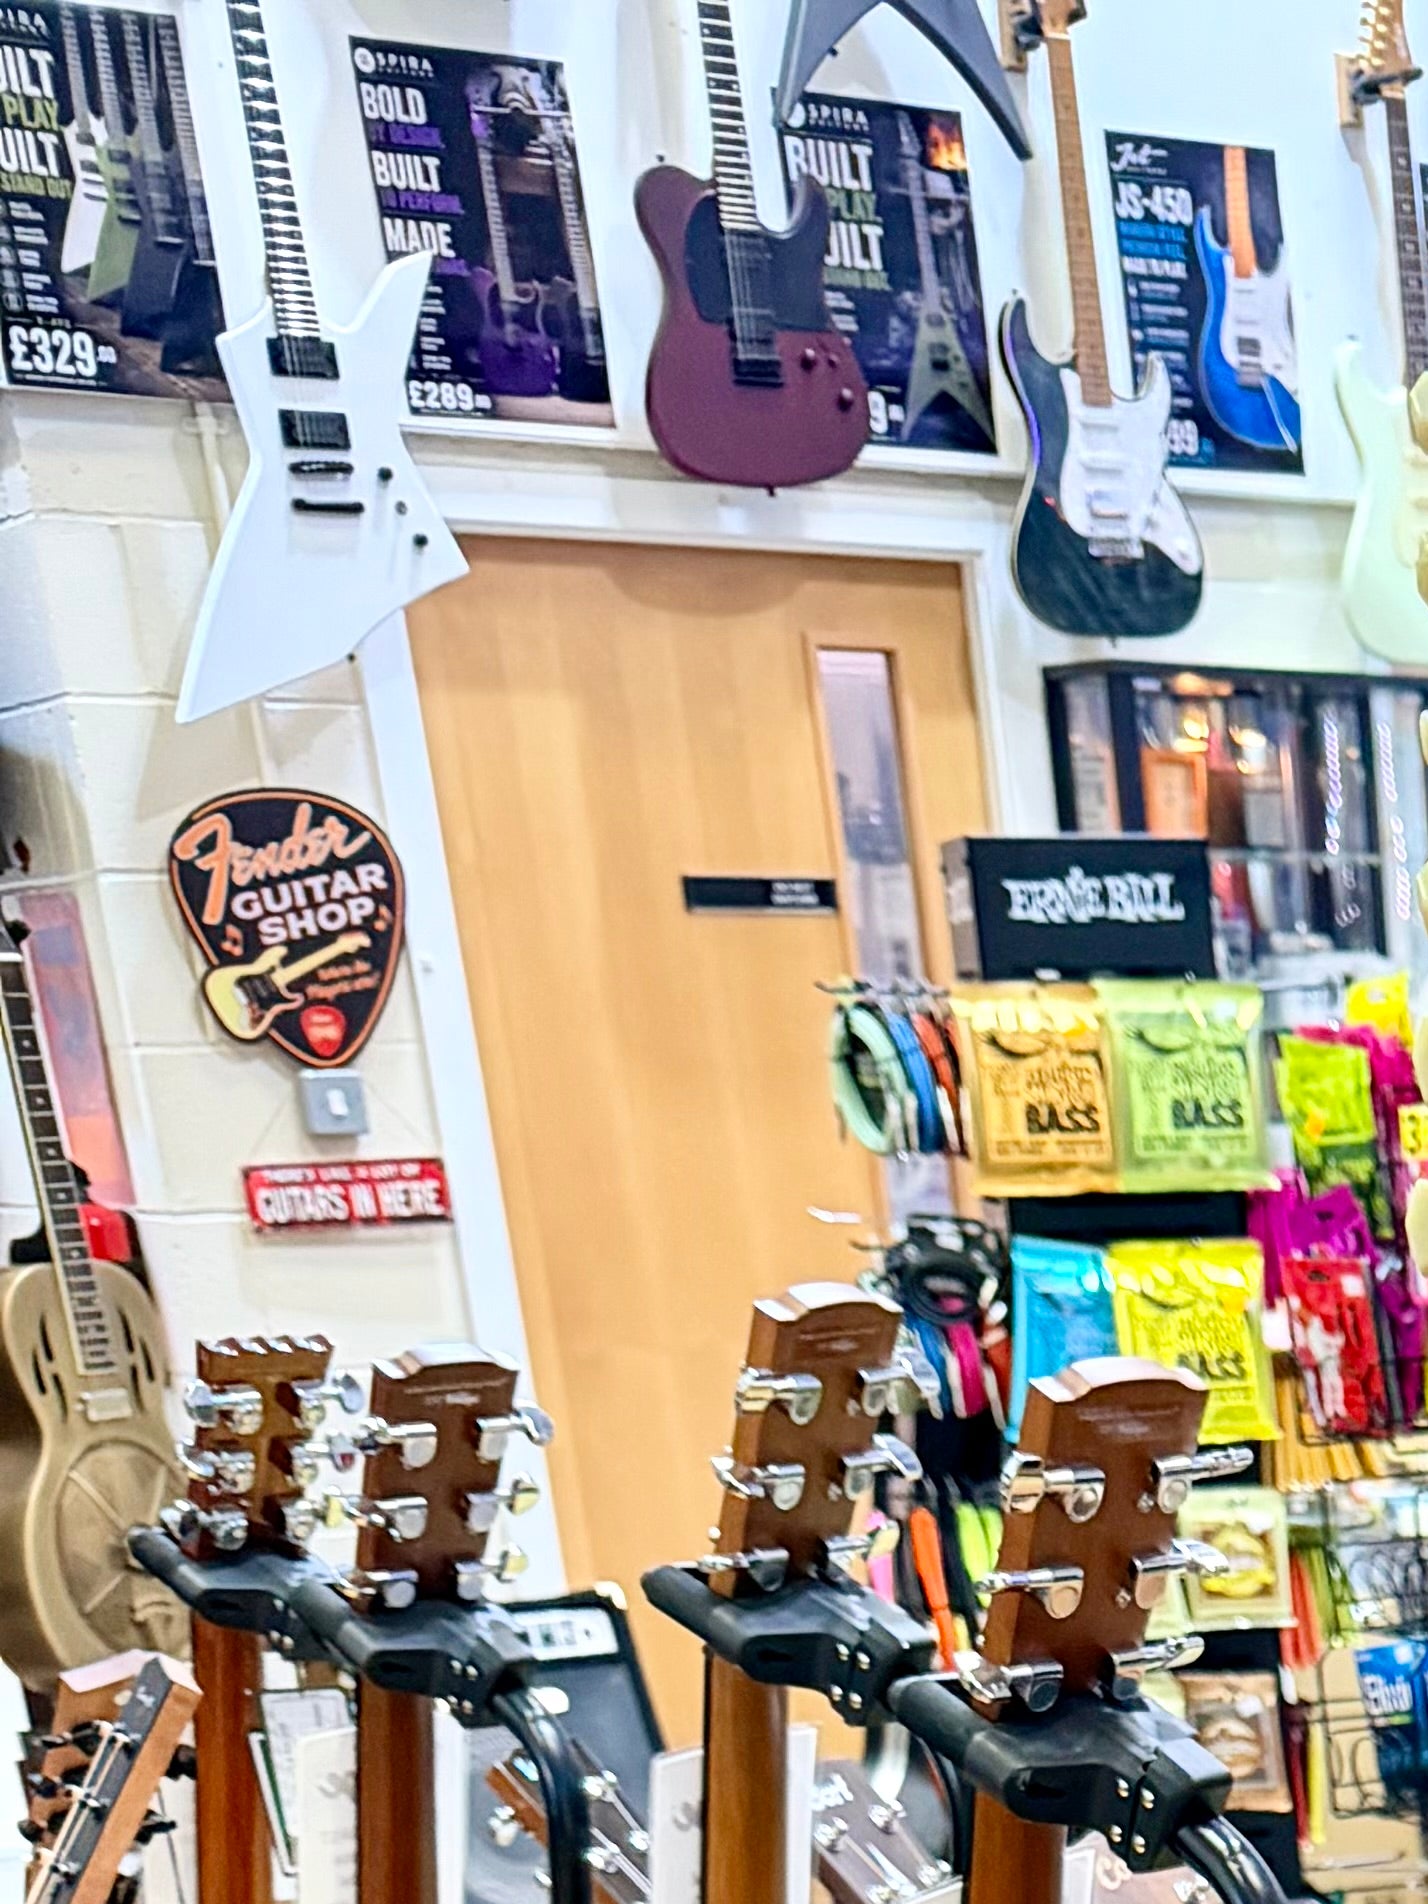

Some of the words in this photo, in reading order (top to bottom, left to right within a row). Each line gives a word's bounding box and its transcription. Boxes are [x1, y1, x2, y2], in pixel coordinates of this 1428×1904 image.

[360, 82, 428, 125] BOLD
[371, 150, 442, 193] BUILT
[383, 217, 457, 258] MADE
[173, 802, 372, 926] Fender
[230, 862, 389, 921] GUITAR
[1001, 865, 1106, 924] ERNIE
[1103, 871, 1186, 924] BALL
[256, 896, 376, 946] SHOP
[1026, 1100, 1101, 1134] BASS
[1170, 1099, 1245, 1129] BASS
